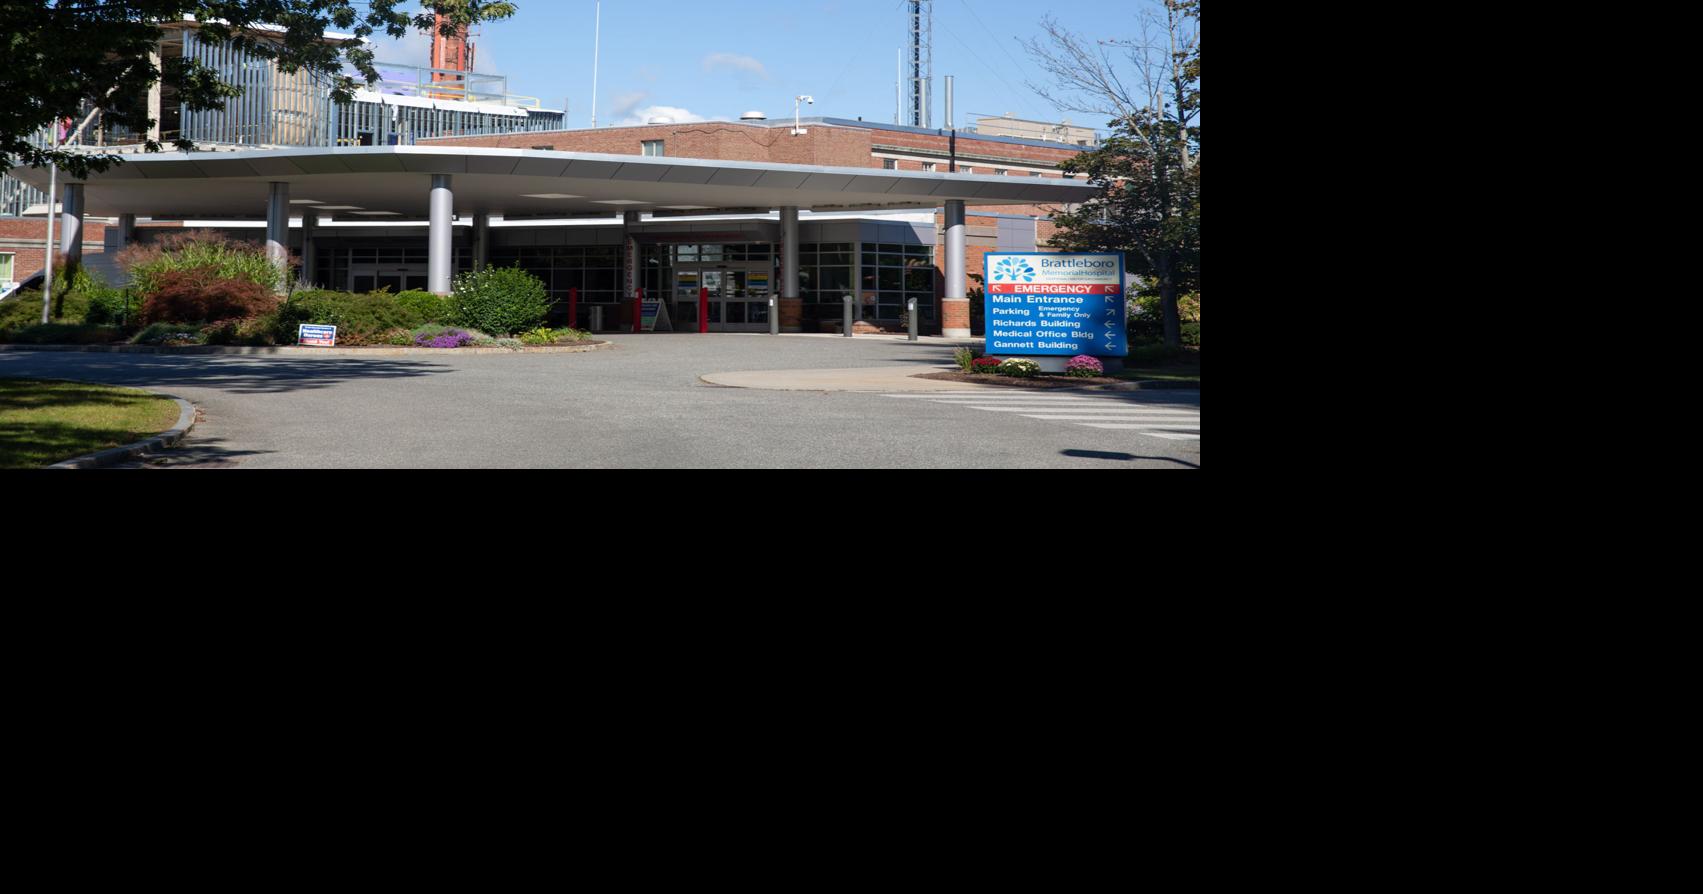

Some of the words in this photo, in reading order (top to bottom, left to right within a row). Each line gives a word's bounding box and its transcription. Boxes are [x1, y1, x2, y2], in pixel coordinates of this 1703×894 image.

[1041, 258, 1114, 268] Brattleboro
[1014, 285, 1092, 293] EMERGENCY
[992, 295, 1021, 303] Main
[1027, 295, 1084, 303] Entrance
[992, 308, 1030, 316] Parking
[1041, 320, 1081, 328] Building
[1071, 331, 1094, 339] Bldg
[1038, 341, 1078, 350] Building
